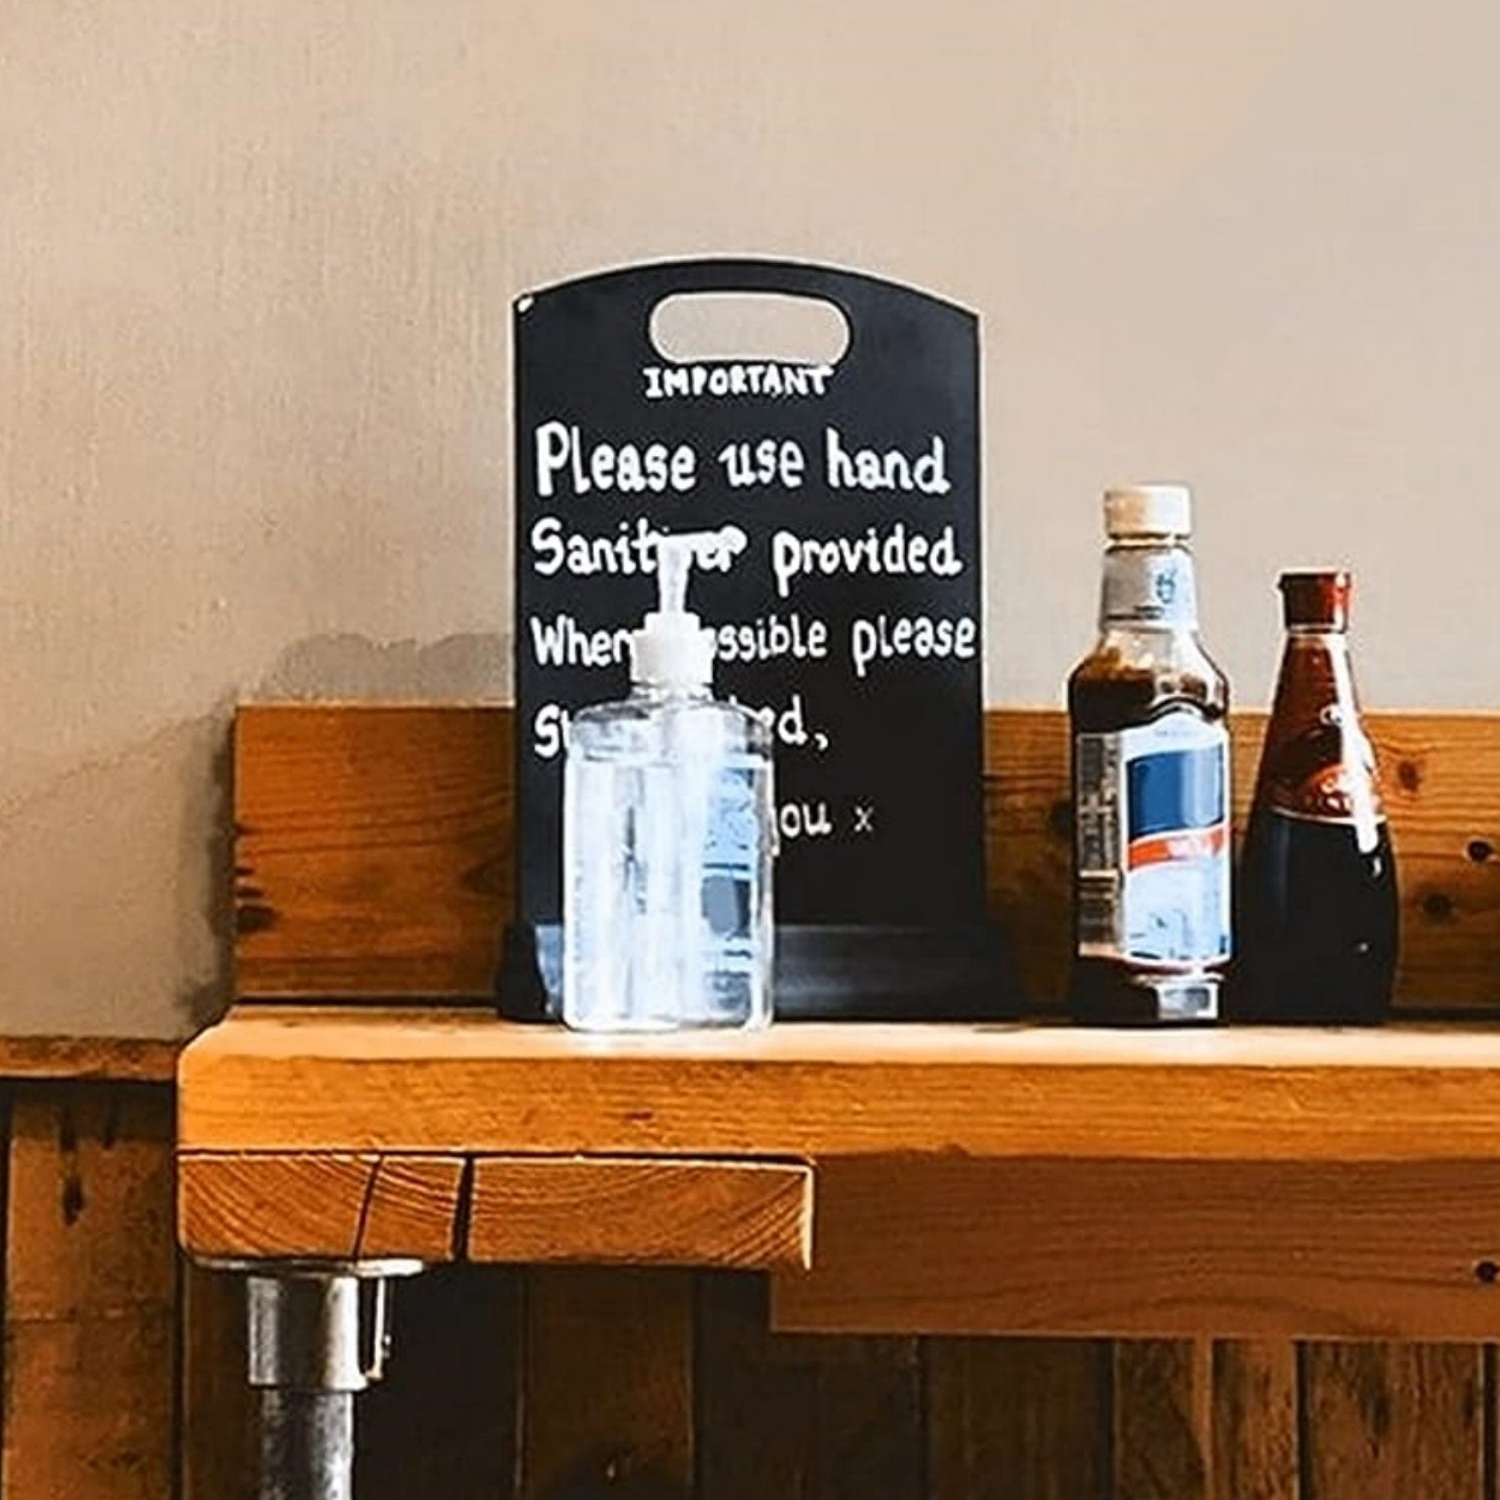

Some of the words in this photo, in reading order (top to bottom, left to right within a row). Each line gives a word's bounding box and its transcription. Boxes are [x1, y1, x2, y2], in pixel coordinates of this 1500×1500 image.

[643, 364, 836, 398] IMPORTANT
[536, 421, 696, 496] Please
[718, 439, 805, 488] use
[827, 427, 951, 494] hand
[531, 516, 744, 576] Saniter
[772, 525, 963, 597] provided
[703, 613, 828, 661] ssible
[852, 614, 976, 678] please
